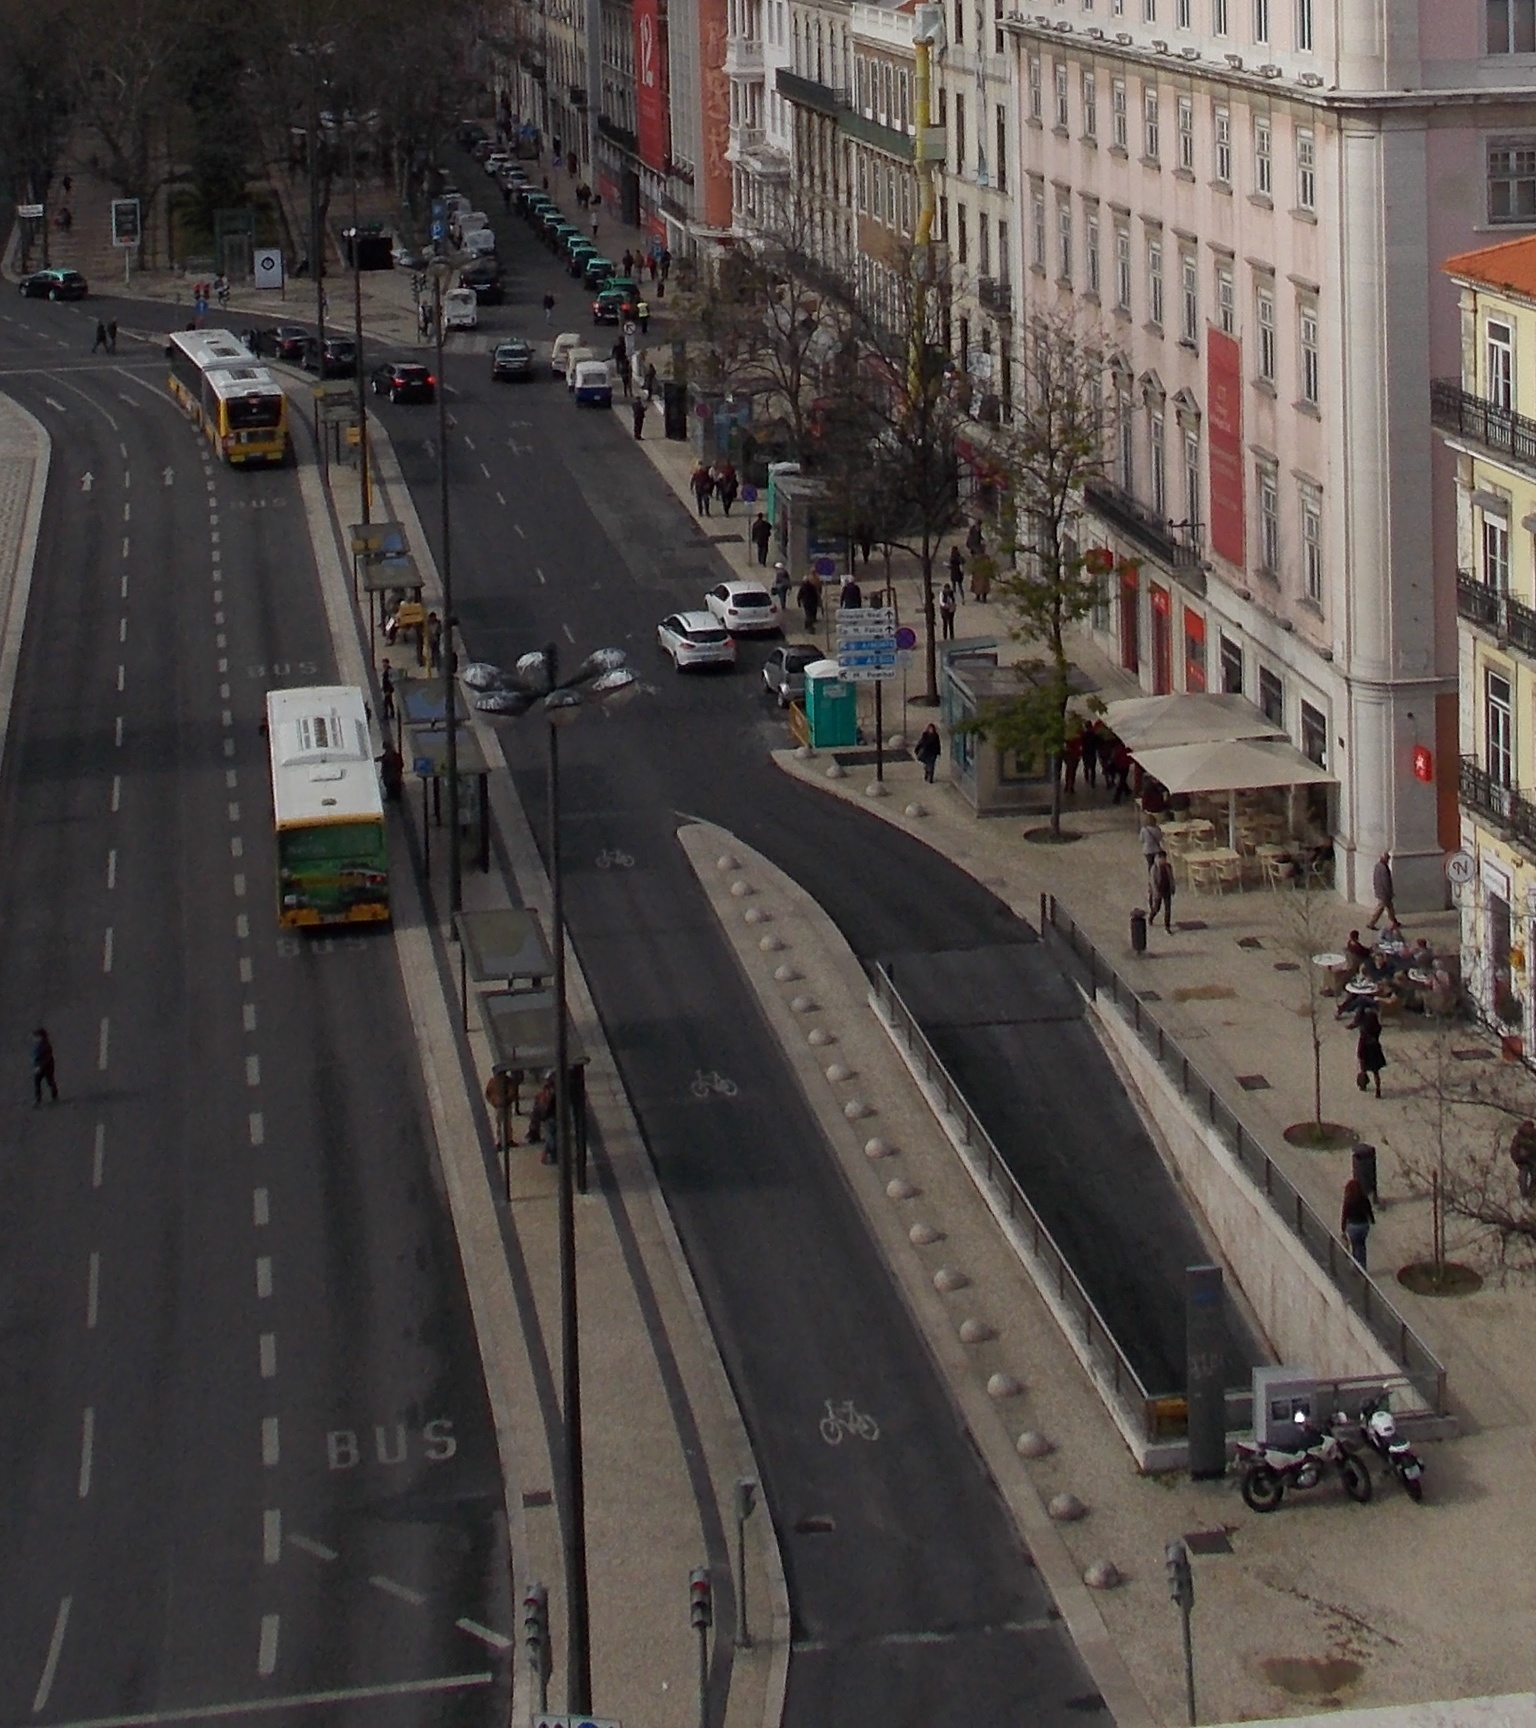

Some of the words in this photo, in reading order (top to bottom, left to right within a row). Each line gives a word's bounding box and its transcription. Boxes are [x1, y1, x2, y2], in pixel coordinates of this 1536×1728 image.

[246, 661, 318, 678] BUS
[276, 936, 369, 958] BUS
[326, 1418, 459, 1471] BUS
